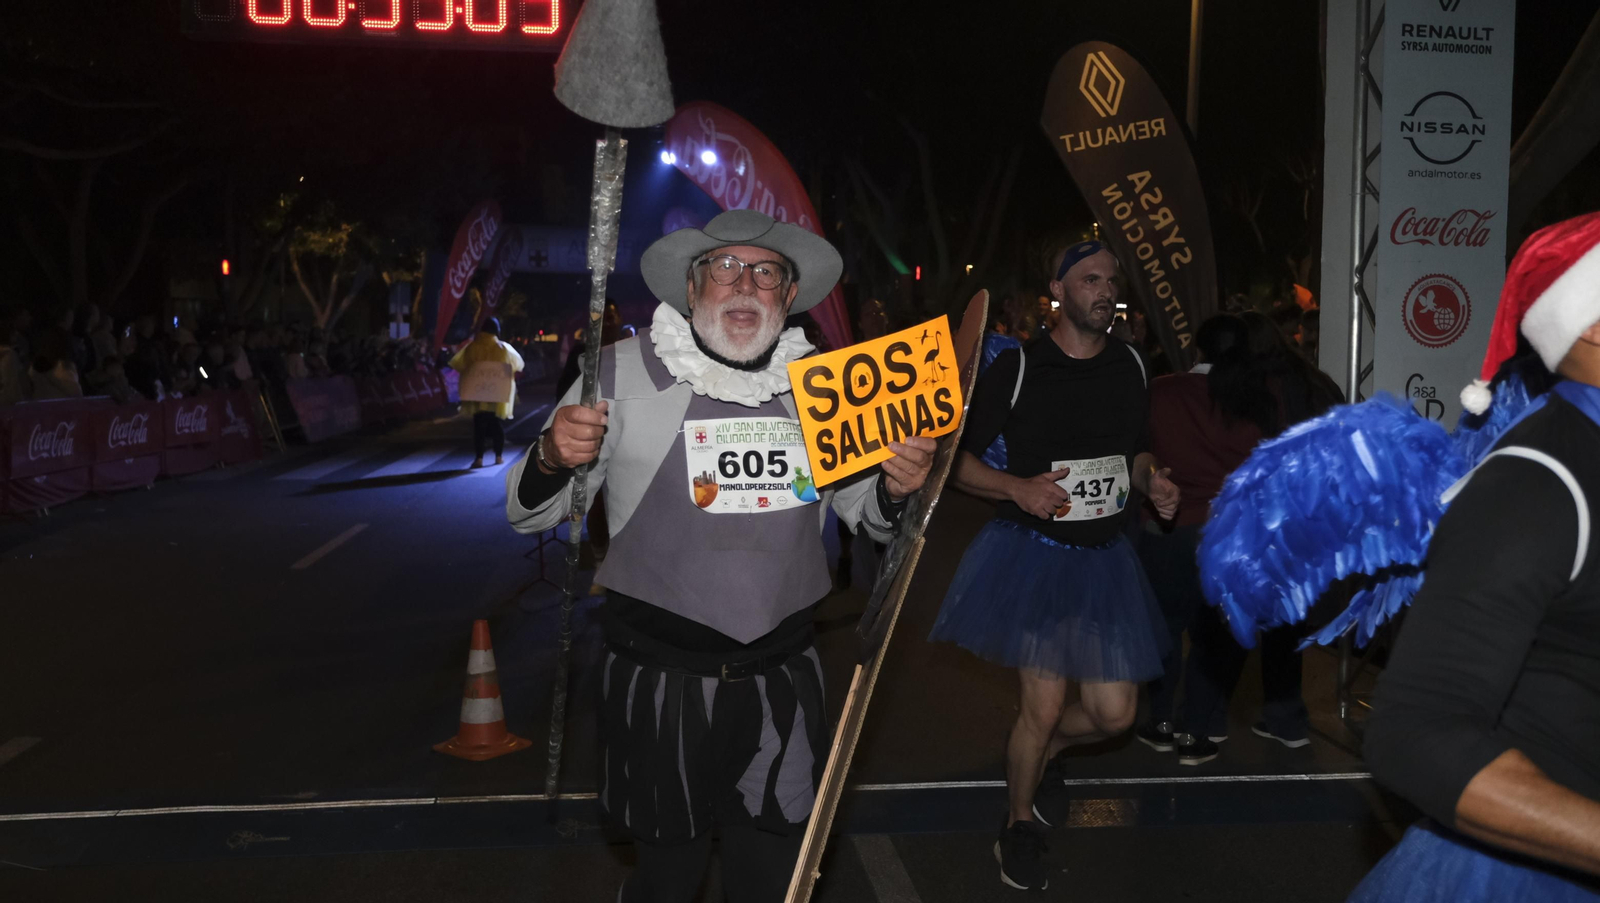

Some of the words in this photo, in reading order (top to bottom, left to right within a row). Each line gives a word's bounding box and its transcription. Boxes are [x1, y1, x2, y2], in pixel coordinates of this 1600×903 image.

[1401, 23, 1494, 41] RENAULT
[1401, 41, 1430, 52] SYRSA
[1431, 42, 1492, 55] AUTOMOCION
[1400, 121, 1486, 136] NISSAN
[1408, 169, 1482, 180] andalmotor.es
[1390, 207, 1498, 248] Coca-Cola
[802, 341, 918, 423] SOS
[715, 422, 731, 433] XIV
[734, 421, 754, 432] SAN
[816, 387, 955, 472] SALINAS
[754, 433, 766, 443] DE
[718, 450, 788, 478] 605
[719, 482, 792, 491] MANOLOPEREZSOLA
[1072, 477, 1115, 498] 437
